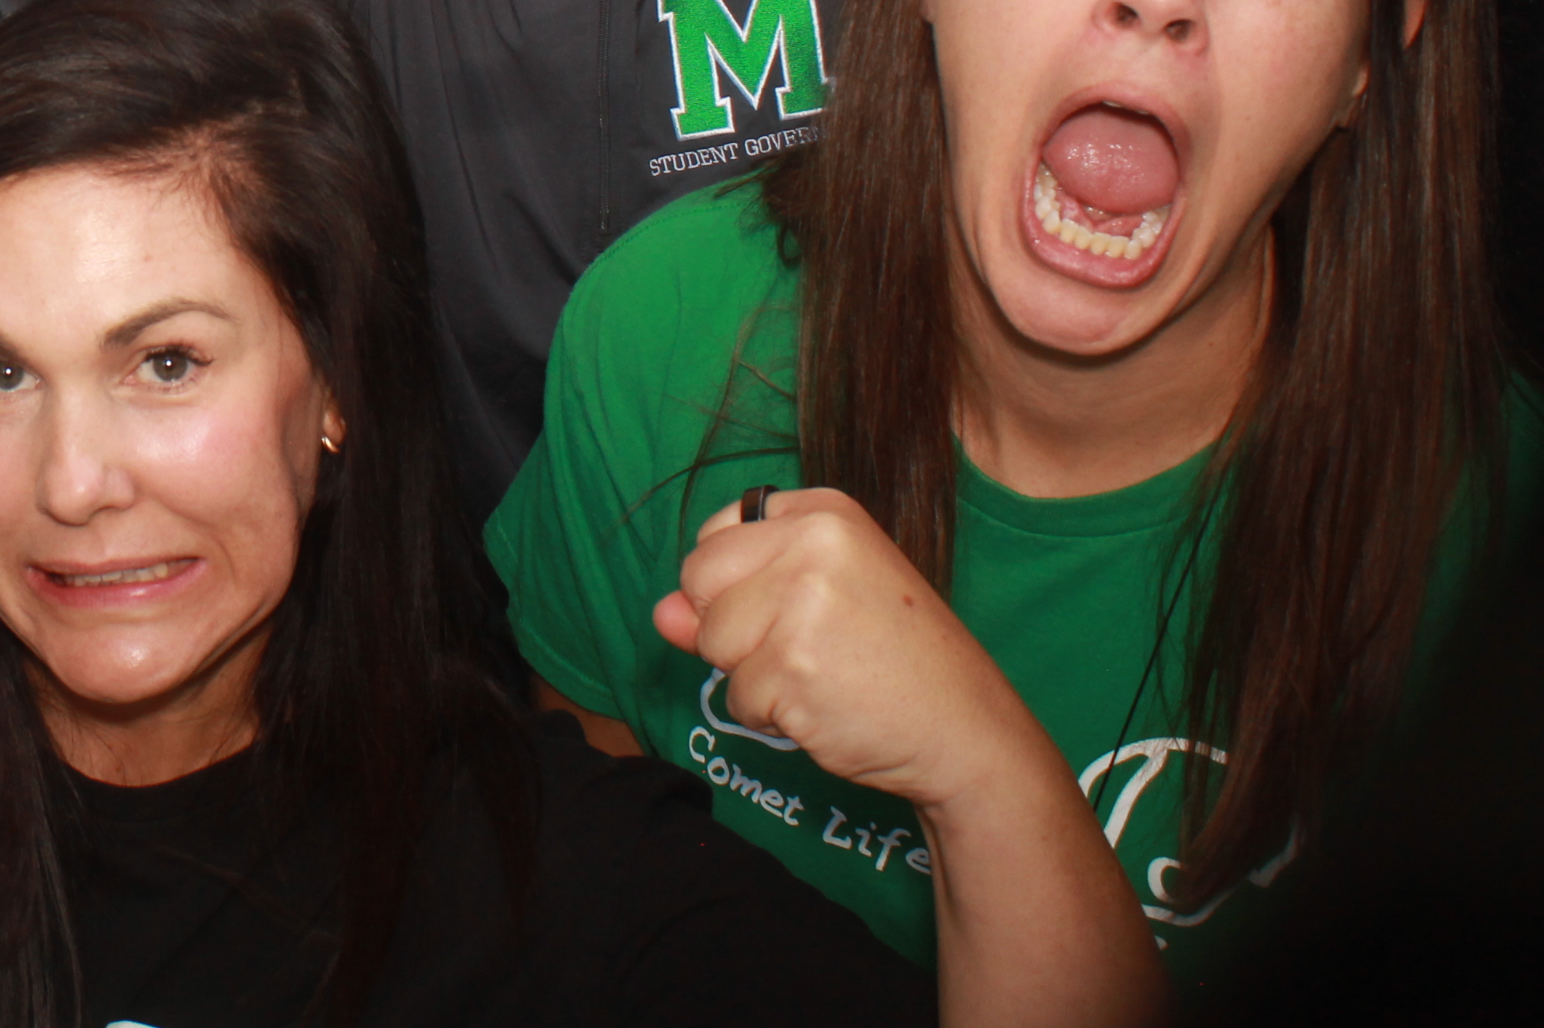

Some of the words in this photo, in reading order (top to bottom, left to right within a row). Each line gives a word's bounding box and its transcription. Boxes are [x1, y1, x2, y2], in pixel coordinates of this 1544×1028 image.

[649, 142, 739, 177] STUDENT
[688, 725, 805, 827] Comet
[822, 805, 931, 876] Life
